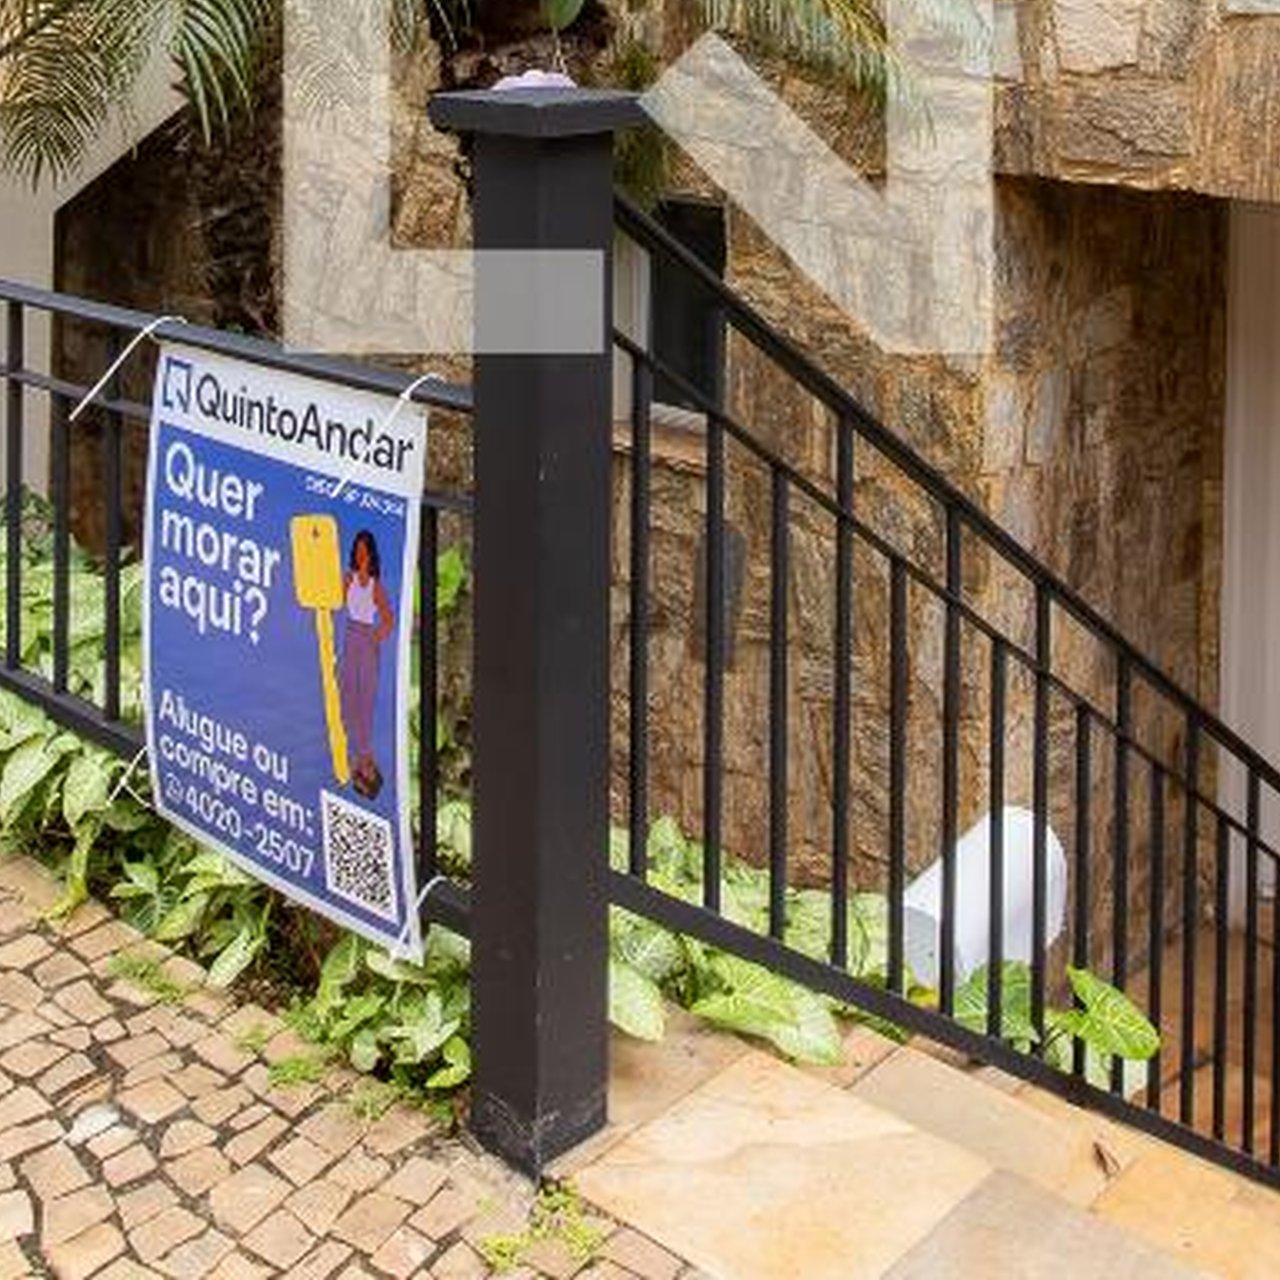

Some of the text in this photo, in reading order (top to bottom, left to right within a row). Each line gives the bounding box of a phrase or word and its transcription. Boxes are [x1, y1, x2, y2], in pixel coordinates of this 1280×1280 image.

[196, 372, 414, 471] QuintoAndar
[166, 441, 264, 520] Quer
[161, 509, 280, 589] morar
[159, 566, 268, 646] aqui?
[159, 690, 288, 783] Alugue ou
[160, 735, 315, 837] compre em:
[185, 786, 315, 878] 4020-2507
